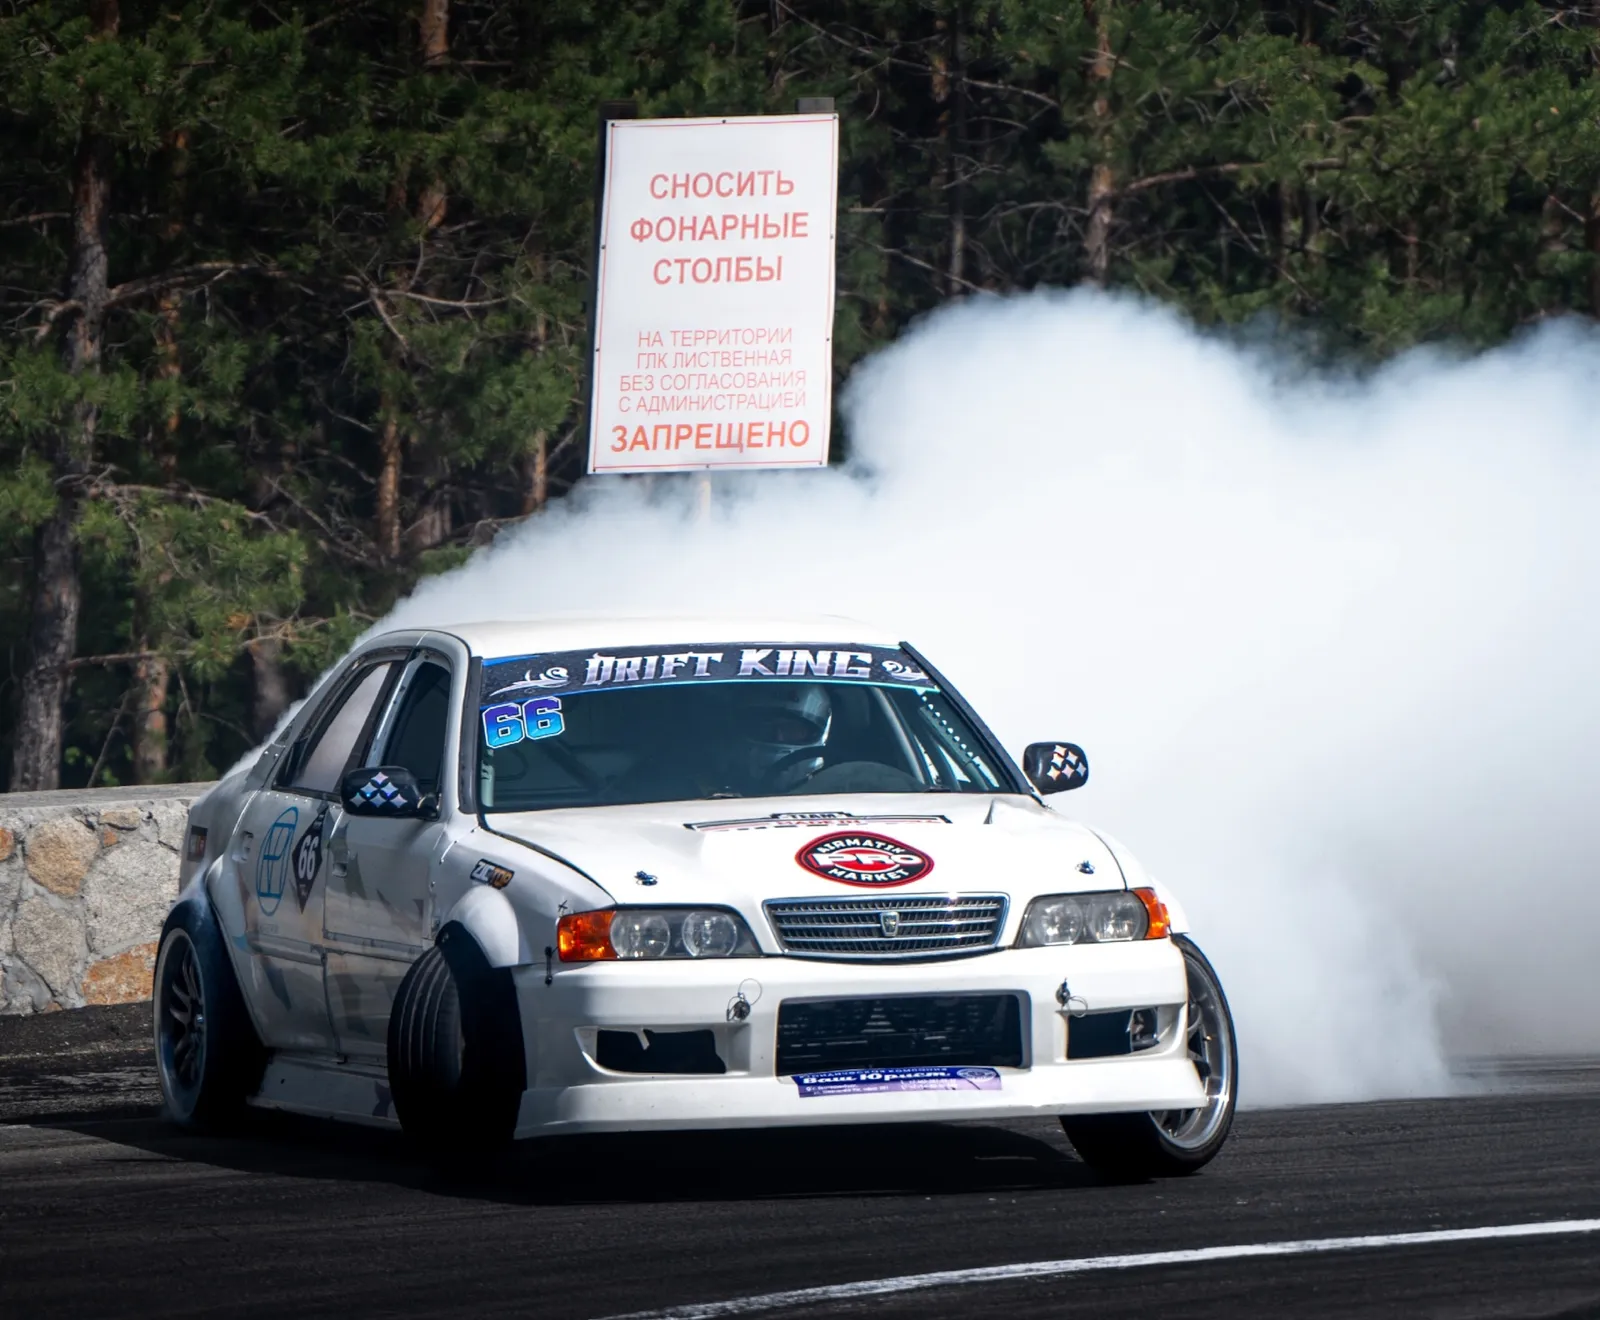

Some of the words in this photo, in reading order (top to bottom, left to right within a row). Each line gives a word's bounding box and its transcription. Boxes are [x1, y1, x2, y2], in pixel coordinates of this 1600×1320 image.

[650, 170, 795, 200] СНОСИТЬ
[630, 212, 810, 243] ФОНАРНЫЕ
[653, 256, 783, 285] СТОЛБЫ
[638, 331, 664, 348] НА
[670, 328, 793, 347] ТЕРРИТОРИИ
[636, 352, 668, 370] ГЛК
[673, 350, 792, 368] ЛИСТВЕННАЯ
[619, 374, 655, 392] БЕЗ
[659, 371, 805, 392] СОГЛАСОВАНИЯ
[618, 396, 631, 413] С
[636, 391, 806, 415] АДМИНИСТРАЦИЕЙ
[611, 420, 810, 454] ЗАПРЕЩЕНО
[582, 651, 724, 686] DRIFT
[739, 648, 873, 680] KING
[481, 696, 566, 748] 66
[298, 834, 320, 880] 66
[810, 852, 924, 867] PRO
[828, 868, 910, 882] MARKET
